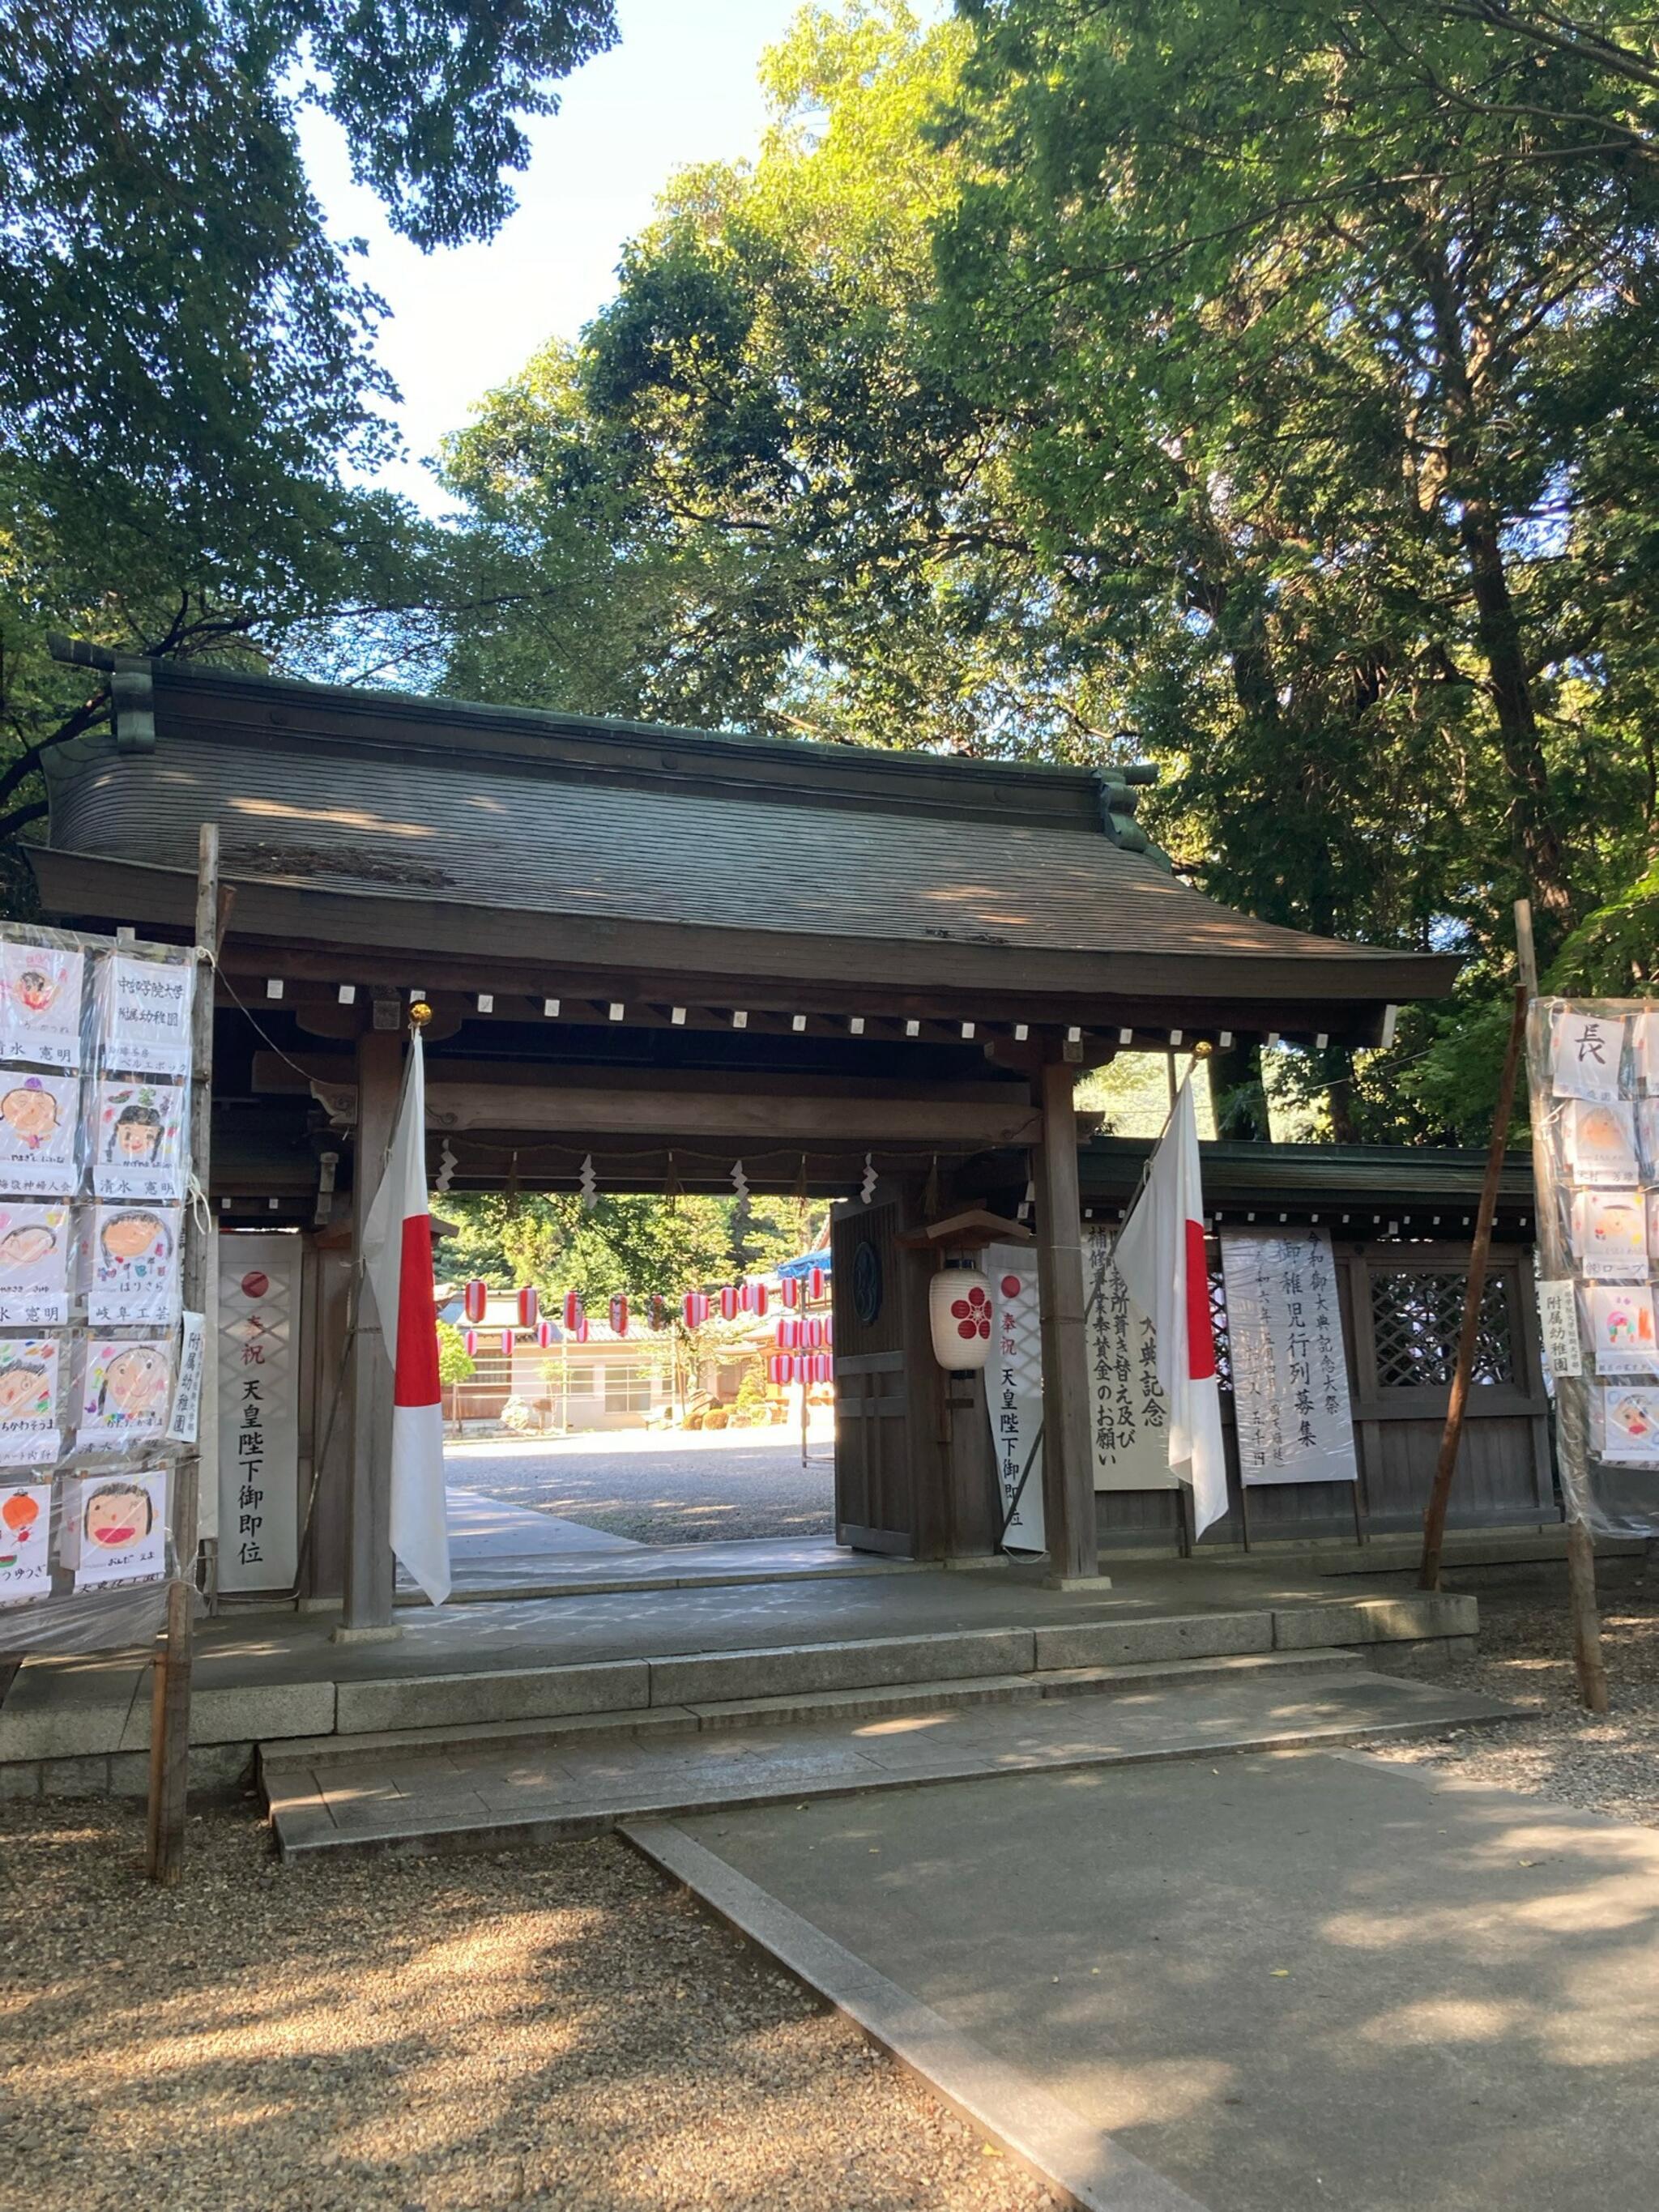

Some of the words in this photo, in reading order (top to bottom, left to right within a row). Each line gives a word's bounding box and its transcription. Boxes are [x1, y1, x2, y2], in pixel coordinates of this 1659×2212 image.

[117, 977, 184, 999] 中部学院大学
[40, 1045, 70, 1063] 憲明
[1574, 1024, 1606, 1064] 長
[100, 1178, 132, 1193] 清水
[144, 1180, 175, 1196] 憲明
[96, 1307, 170, 1320] 岐阜工芸
[999, 1311, 1017, 1356] 奉祝
[1547, 1296, 1568, 1372] 附属幼稚園
[241, 1315, 266, 1366] 奉祝
[1277, 1238, 1317, 1447] 御稚児行列募集
[173, 1332, 200, 1434] 附属幼稚園
[1138, 1316, 1167, 1428] 大典記念
[238, 1379, 265, 1565] 天皇陛下御即位
